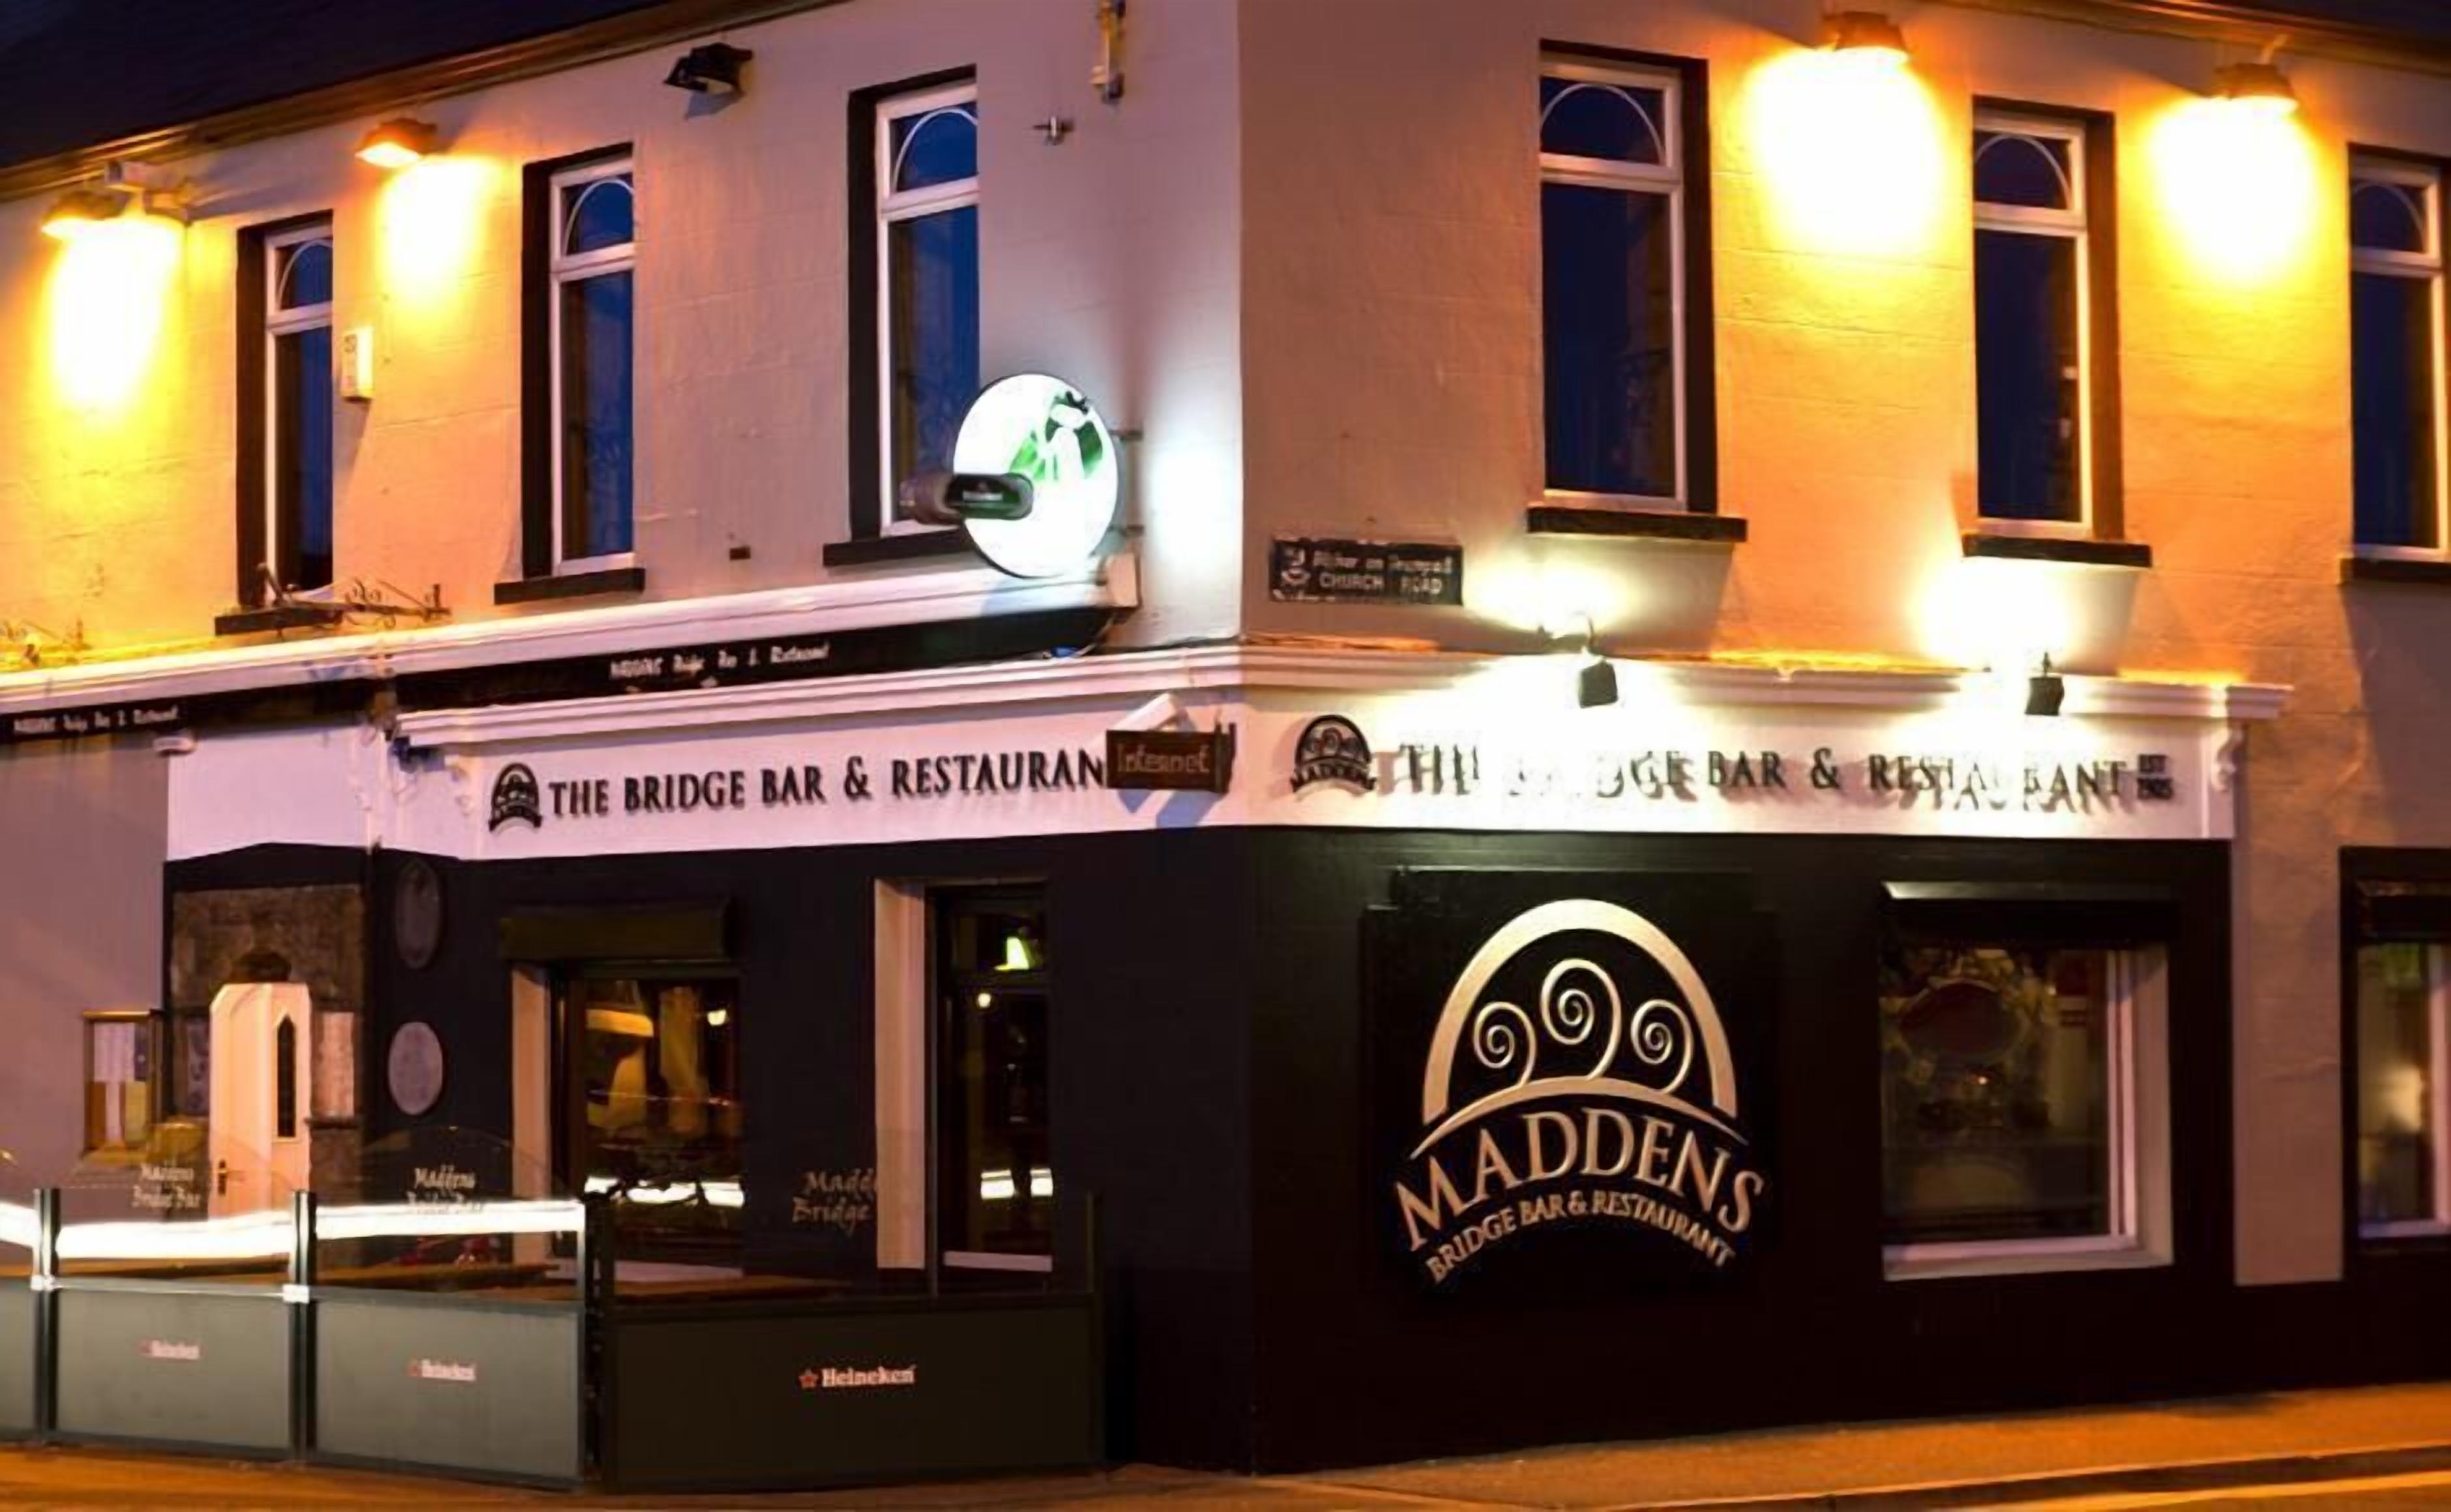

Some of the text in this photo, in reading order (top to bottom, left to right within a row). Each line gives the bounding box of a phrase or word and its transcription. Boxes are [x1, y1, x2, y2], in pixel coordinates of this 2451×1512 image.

[1319, 572, 1384, 589] CHURCH
[549, 779, 609, 817] THE
[624, 770, 746, 813] BRIDGE
[760, 764, 827, 807] BAR
[844, 755, 872, 801] &
[892, 749, 1108, 802] RESTAURAN
[1709, 751, 1785, 789] BAR
[1810, 748, 1840, 789] &
[1869, 753, 2127, 796] RESTARANT
[801, 1168, 878, 1200] Madd
[1394, 1107, 1763, 1251] MADDENS
[1426, 1189, 1735, 1284] BRIDGE BAR & RESTAURANT
